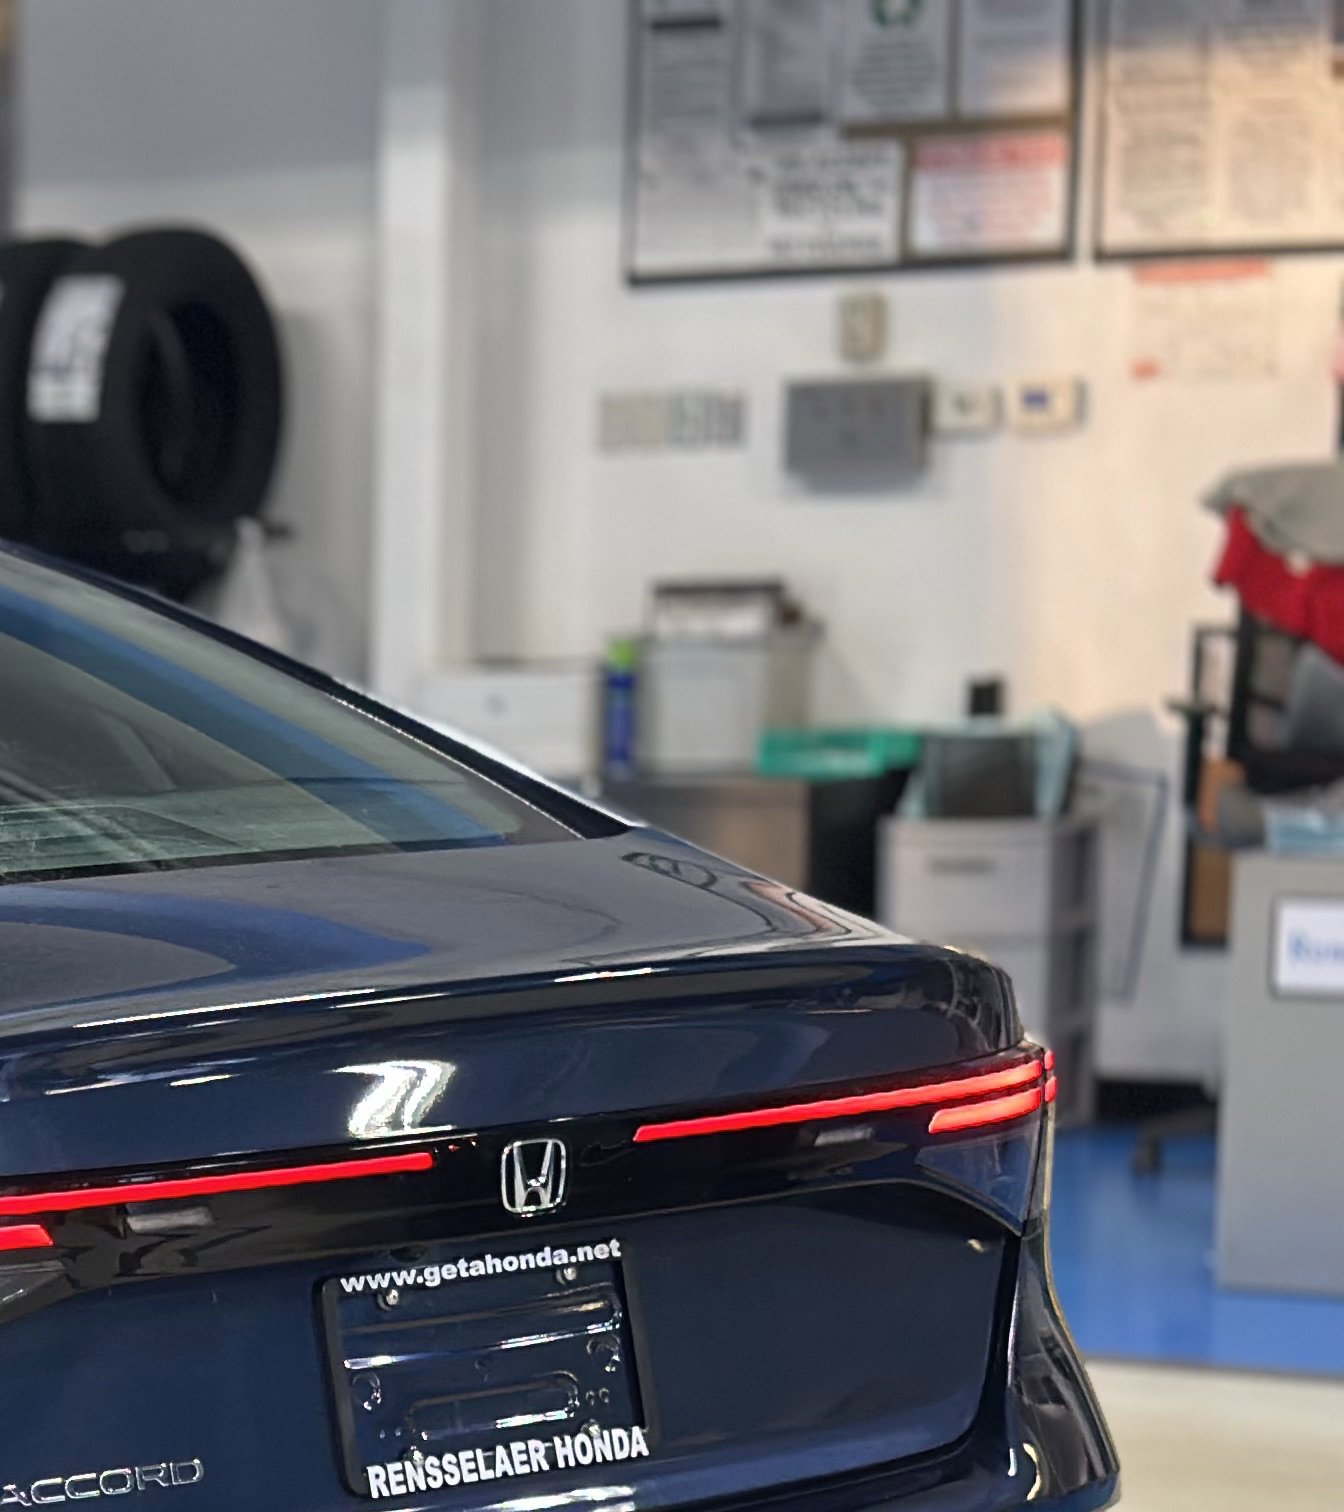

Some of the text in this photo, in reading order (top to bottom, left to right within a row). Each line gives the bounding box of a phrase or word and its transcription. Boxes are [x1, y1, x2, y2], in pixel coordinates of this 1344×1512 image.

[340, 1238, 622, 1294] www.getahonda.net
[366, 1426, 650, 1499] RENSSELAER HONDA
